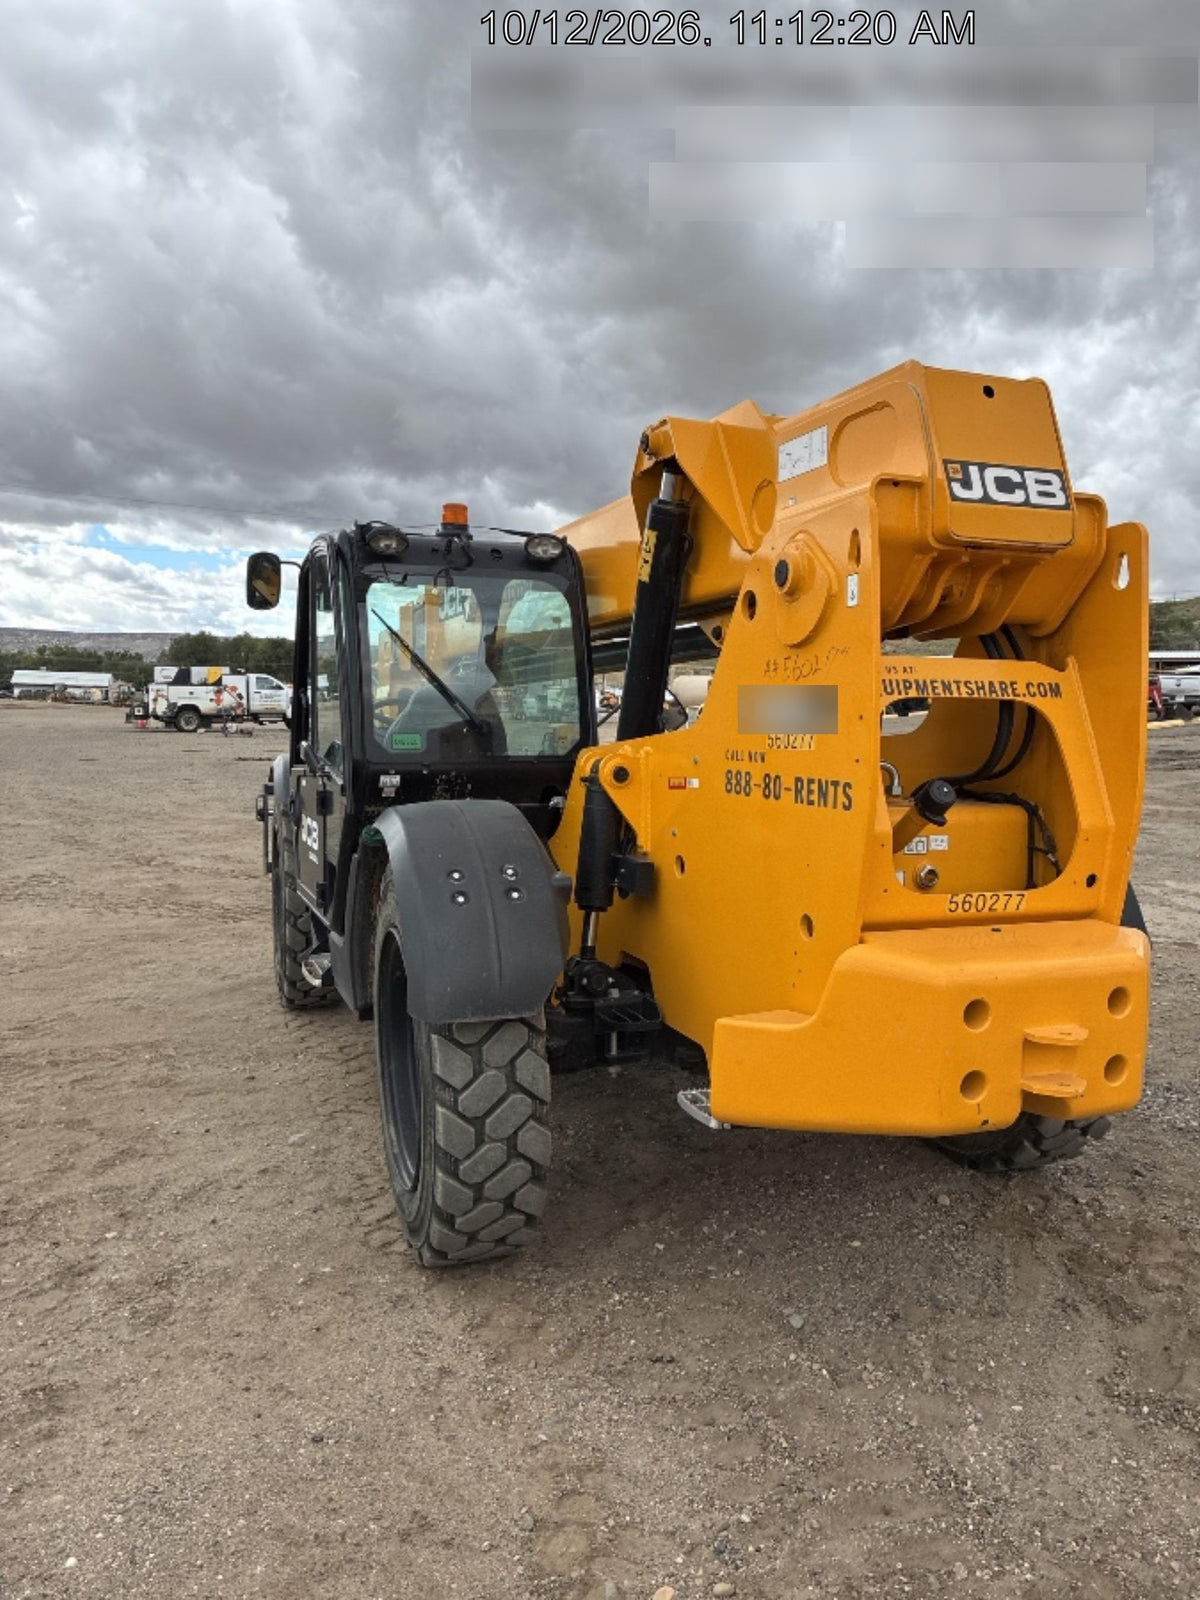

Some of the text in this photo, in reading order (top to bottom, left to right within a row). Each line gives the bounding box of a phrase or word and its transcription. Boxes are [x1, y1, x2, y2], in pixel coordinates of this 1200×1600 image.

[951, 465, 1067, 505] JCB
[880, 678, 1062, 699] UIPMENTSHARE.COM
[748, 750, 767, 764] NOW
[725, 769, 853, 811] 888-80-RENTS
[948, 893, 1026, 913] 560277
